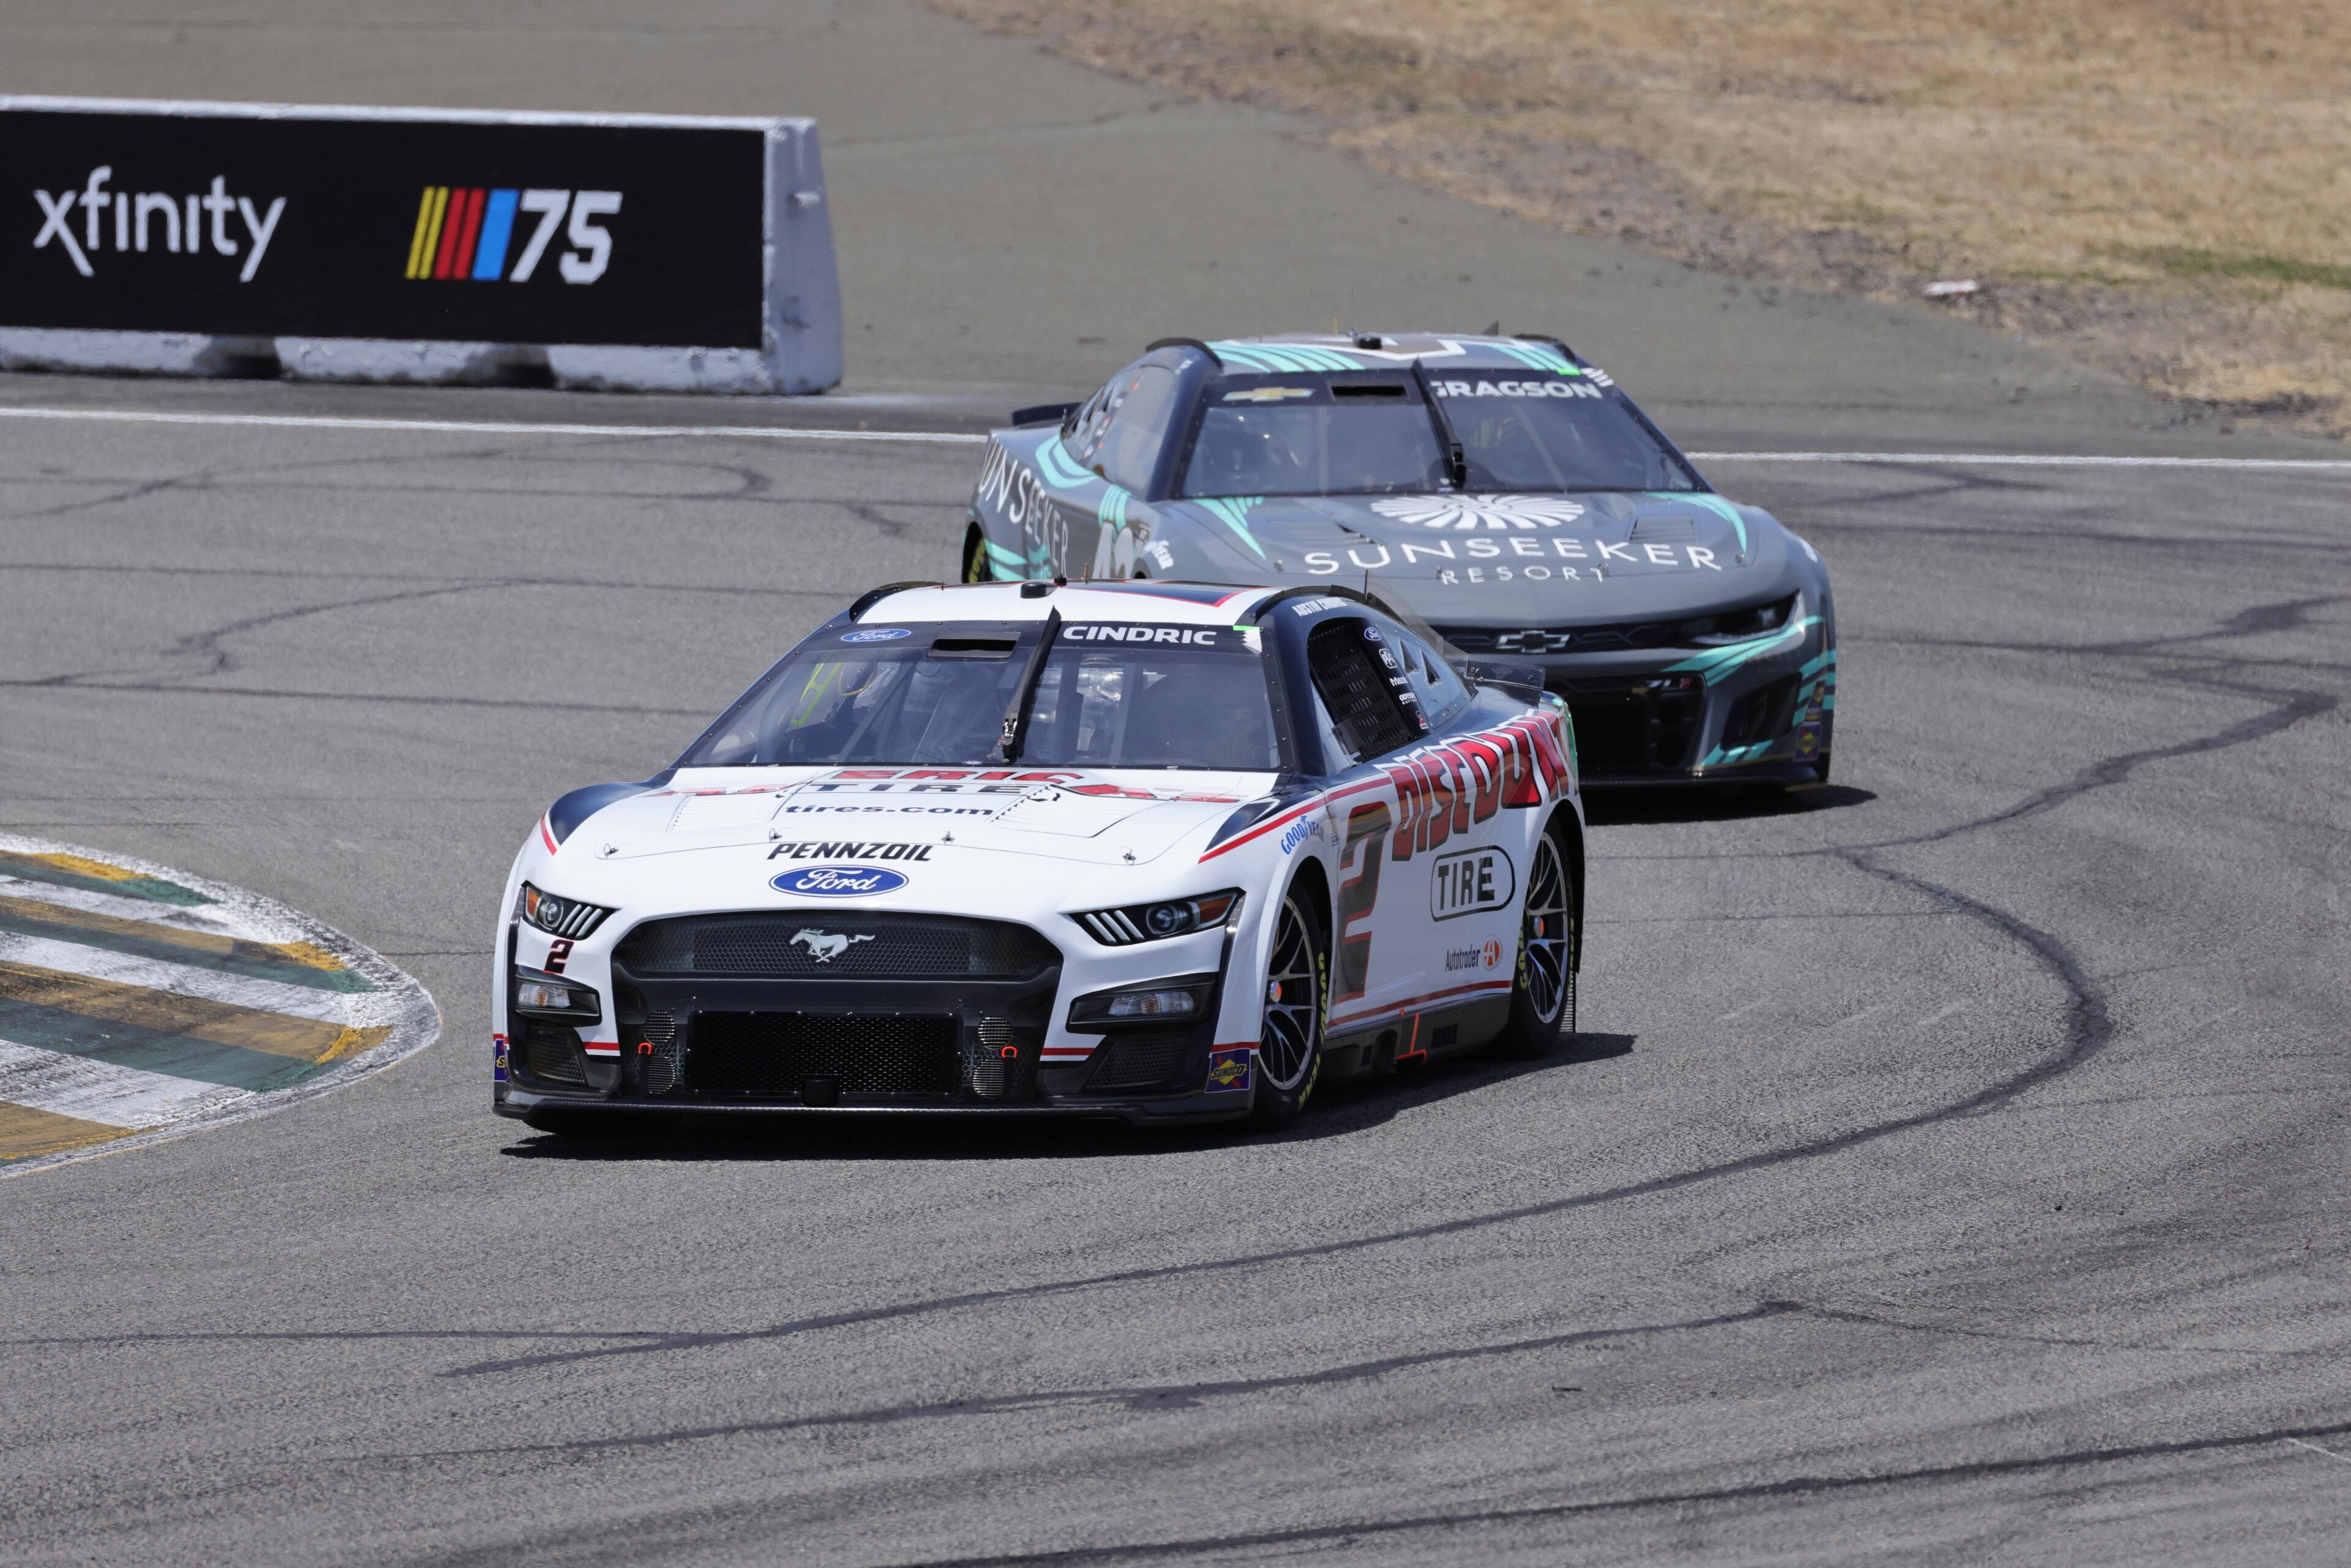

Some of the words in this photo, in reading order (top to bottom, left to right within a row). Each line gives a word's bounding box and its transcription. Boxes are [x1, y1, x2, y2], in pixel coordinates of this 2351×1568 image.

[33, 165, 287, 282] xfinity
[510, 189, 623, 284] 75
[980, 432, 1068, 578] UNSEEKER
[1304, 537, 1722, 576] SUNSEEKER
[1441, 565, 1606, 586] RESORT
[1063, 626, 1218, 645] CINDRIC
[809, 784, 1030, 794] TIRE
[1381, 709, 1578, 861] DISCOUN
[786, 805, 994, 816] tires.com
[767, 842, 933, 862] PENNZOIL
[1438, 856, 1495, 911] TIRE
[1330, 801, 1392, 1007] 2
[542, 939, 574, 974] 2
[1445, 943, 1480, 972] Autotrader
